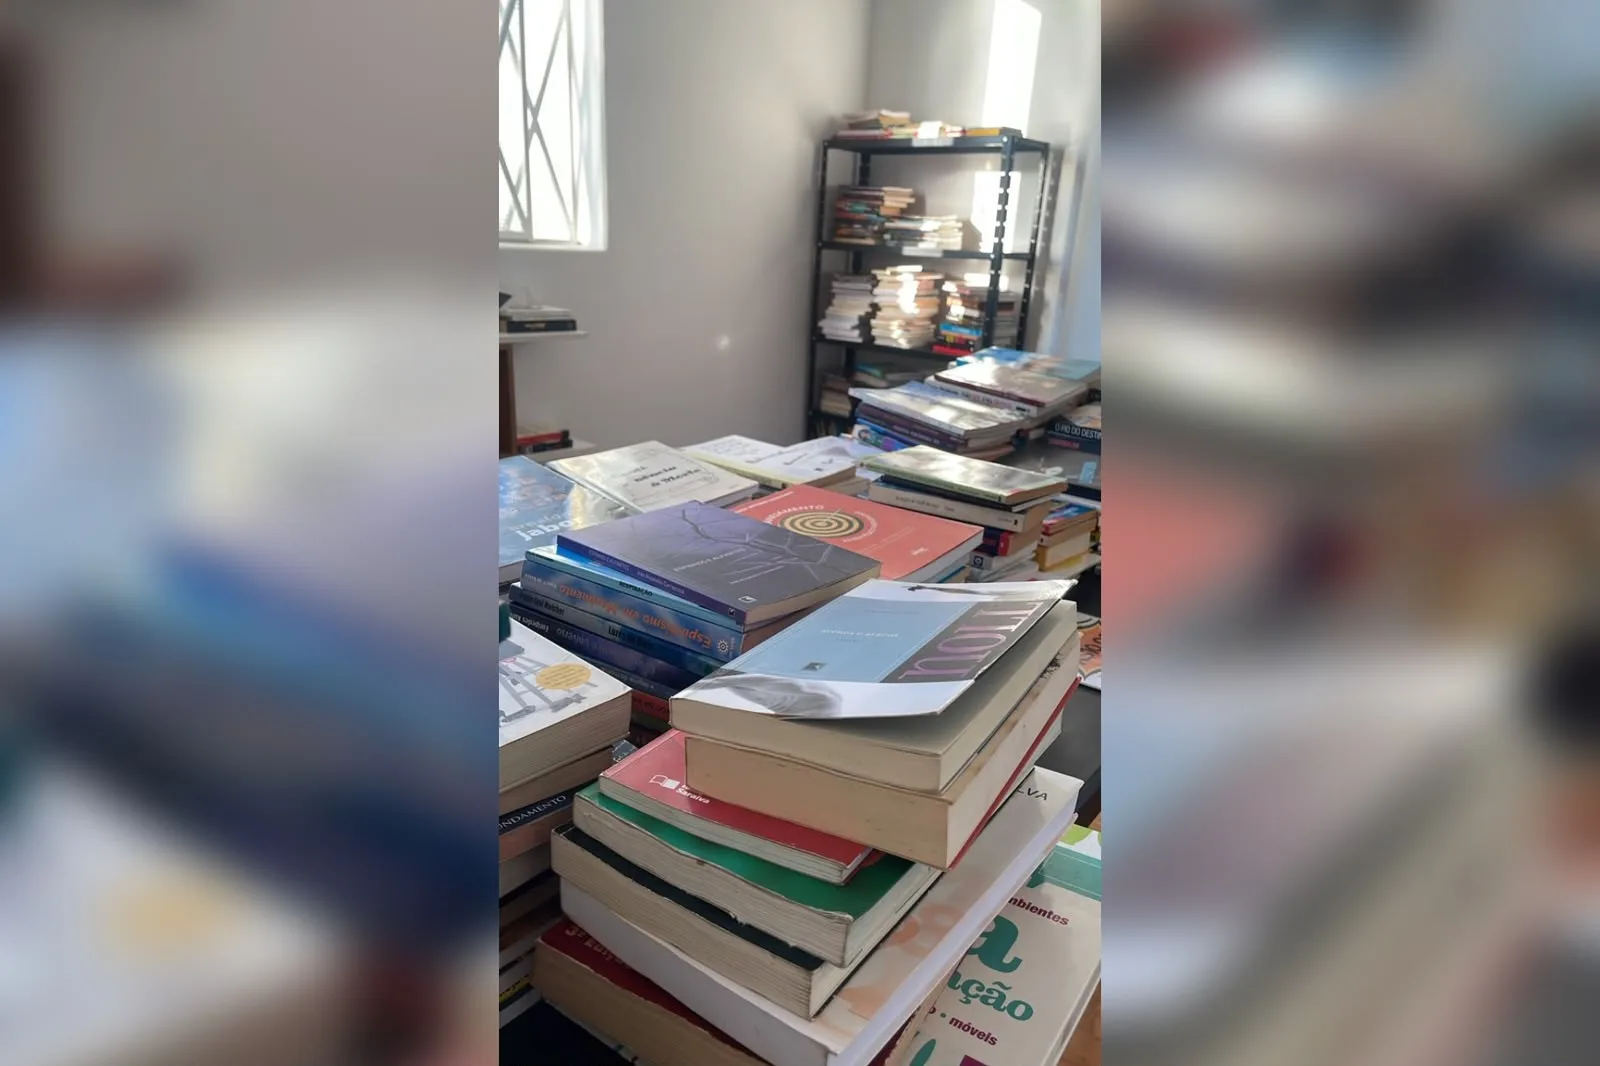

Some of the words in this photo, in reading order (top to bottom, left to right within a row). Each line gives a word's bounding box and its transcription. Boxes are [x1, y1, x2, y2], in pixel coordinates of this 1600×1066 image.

[515, 519, 578, 541] Jabo
[675, 787, 710, 804] Saraiva
[948, 1016, 998, 1046] móveis
